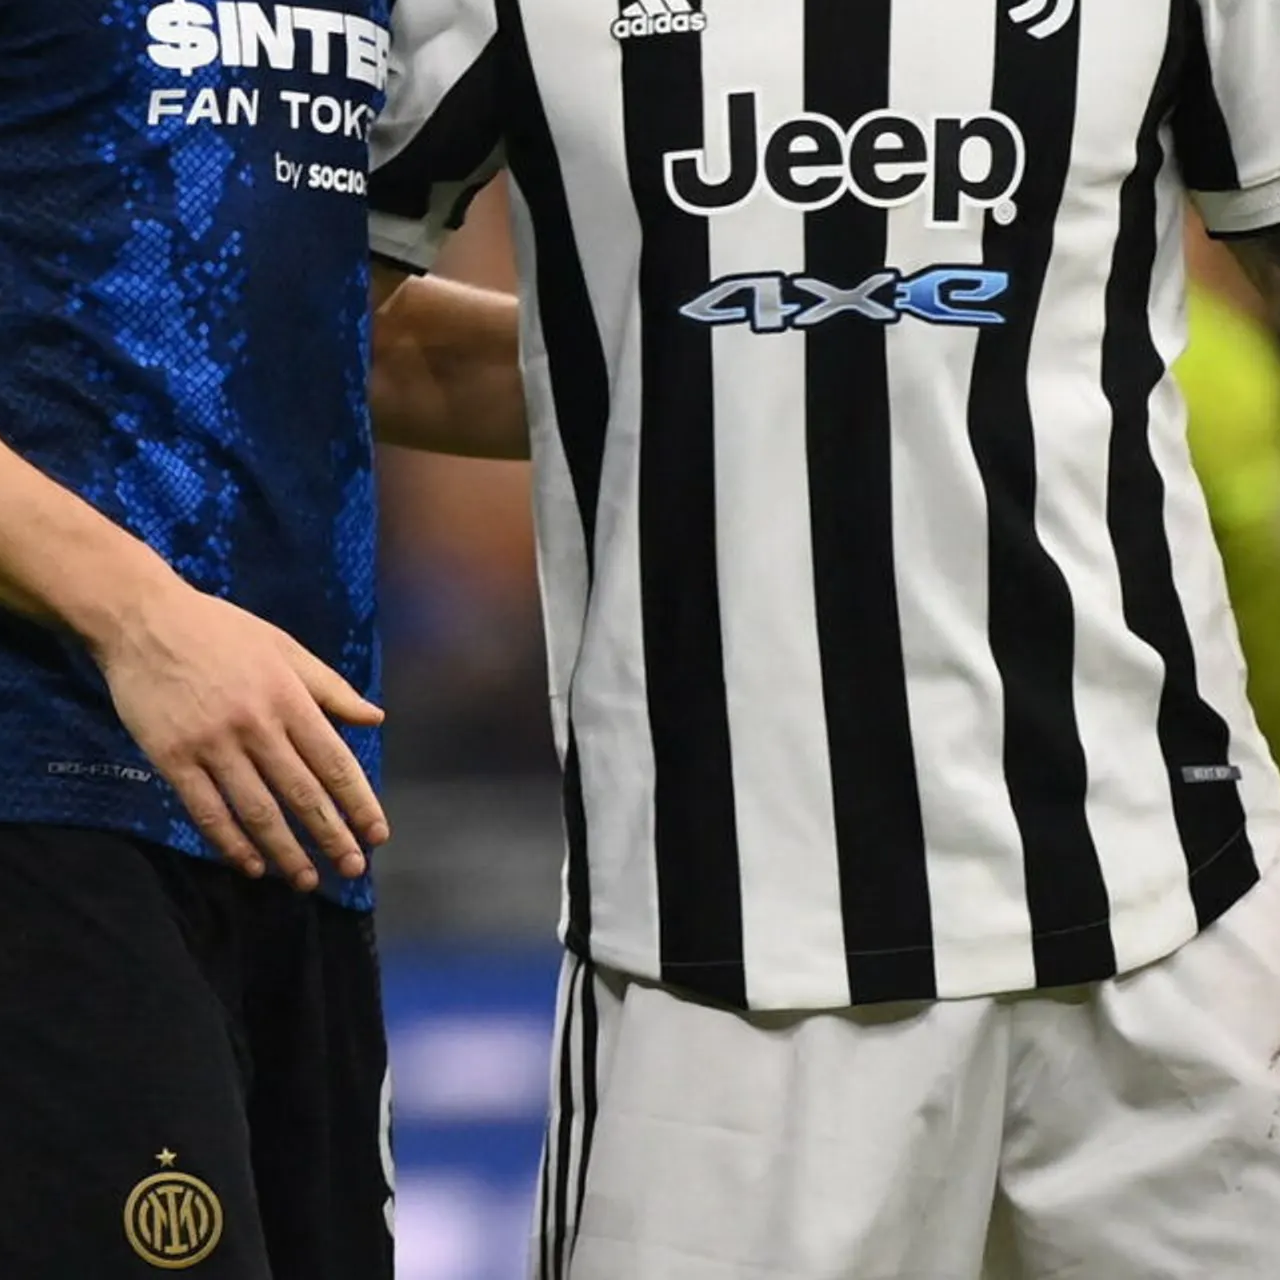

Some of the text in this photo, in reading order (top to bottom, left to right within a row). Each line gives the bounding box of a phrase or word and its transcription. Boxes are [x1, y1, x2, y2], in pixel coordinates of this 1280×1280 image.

[611, 12, 706, 39] adidas
[147, 87, 375, 142] FAN TOK
[275, 151, 302, 189] by
[667, 90, 1021, 225] Jeep
